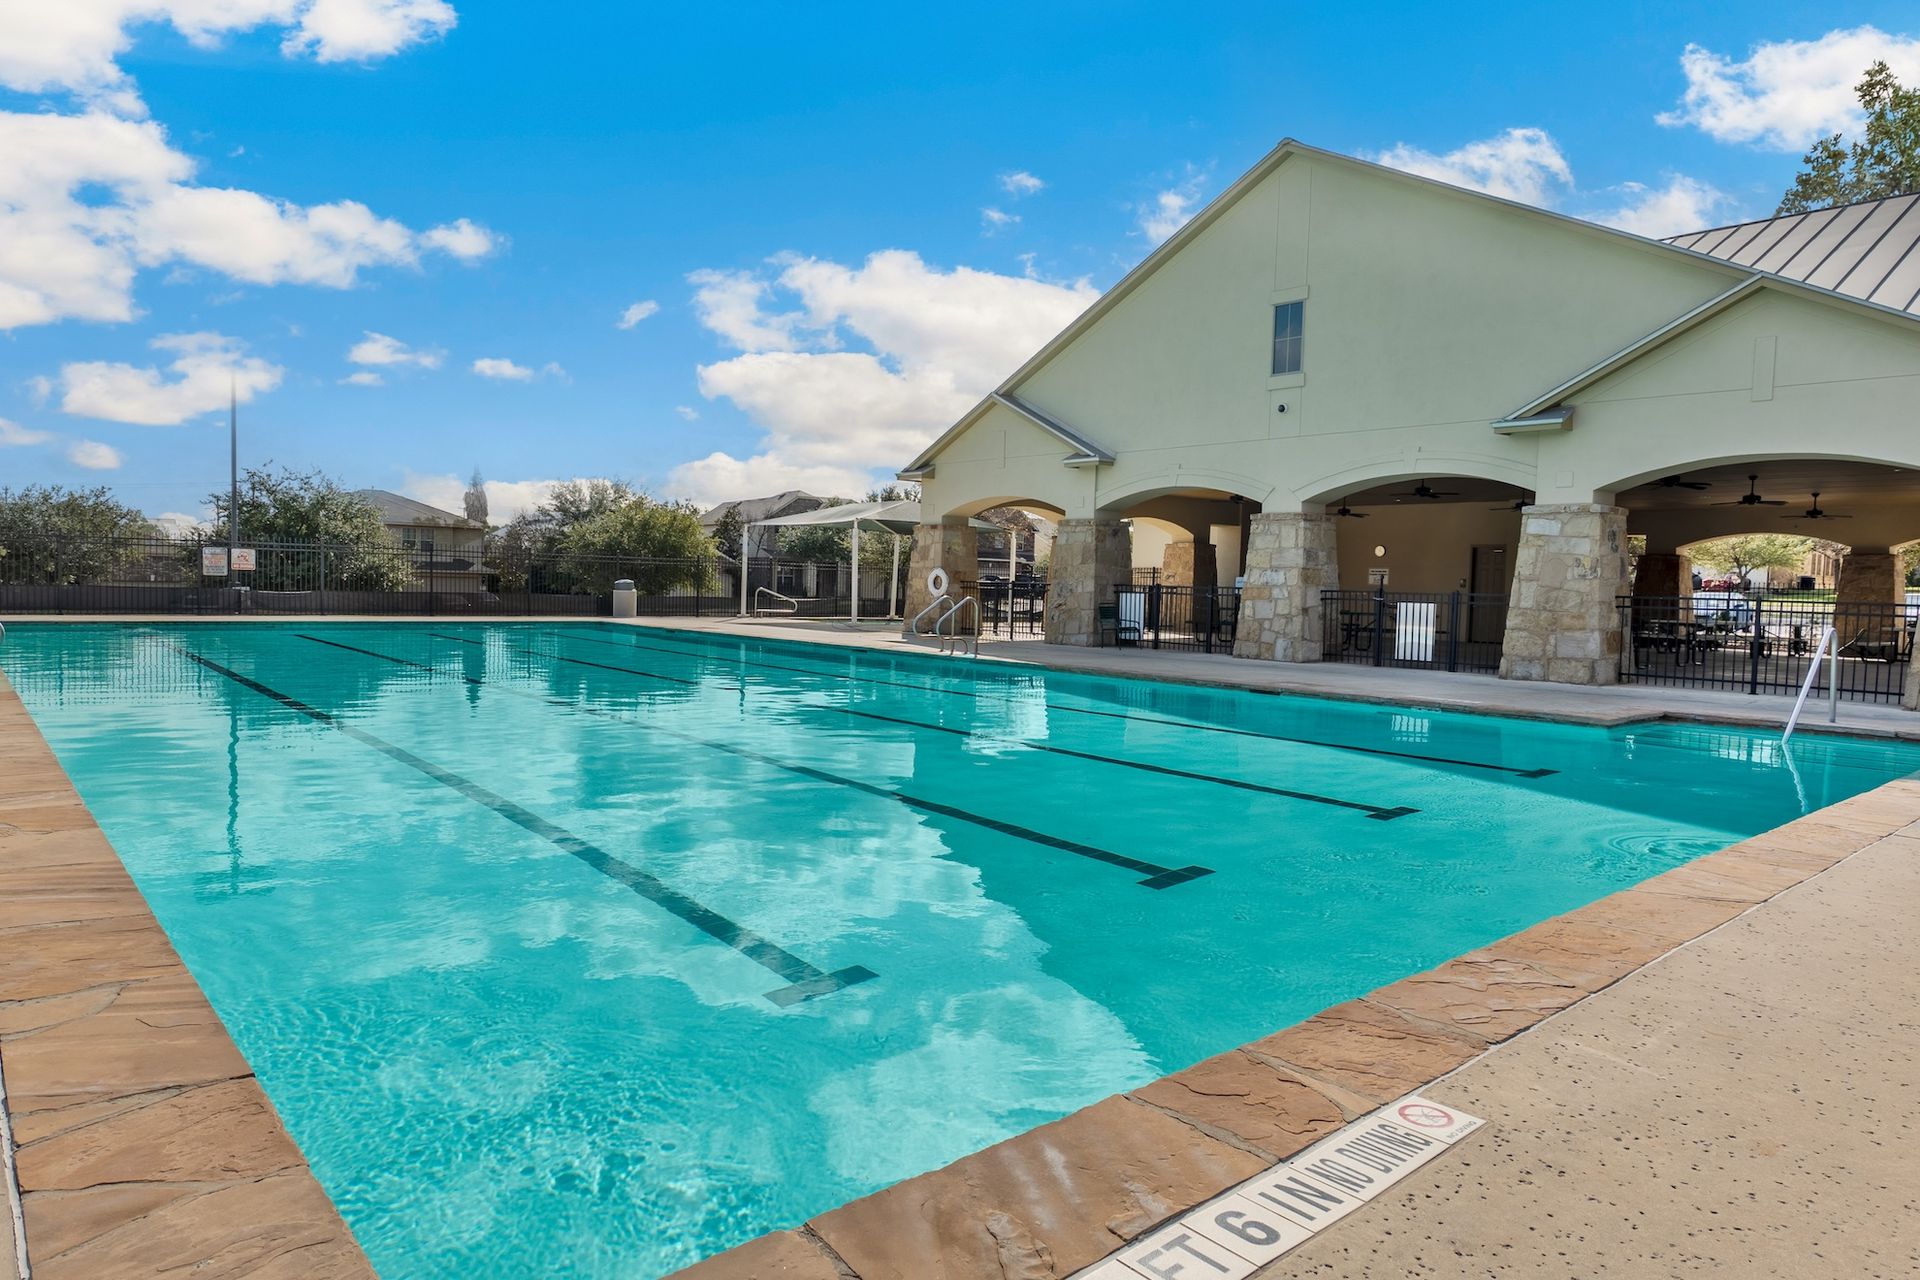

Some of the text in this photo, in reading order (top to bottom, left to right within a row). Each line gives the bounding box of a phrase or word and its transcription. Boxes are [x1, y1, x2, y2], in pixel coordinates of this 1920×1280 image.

[1304, 1123, 1433, 1193] NO DIVING
[1135, 1176, 1345, 1280] FT 6 IN
